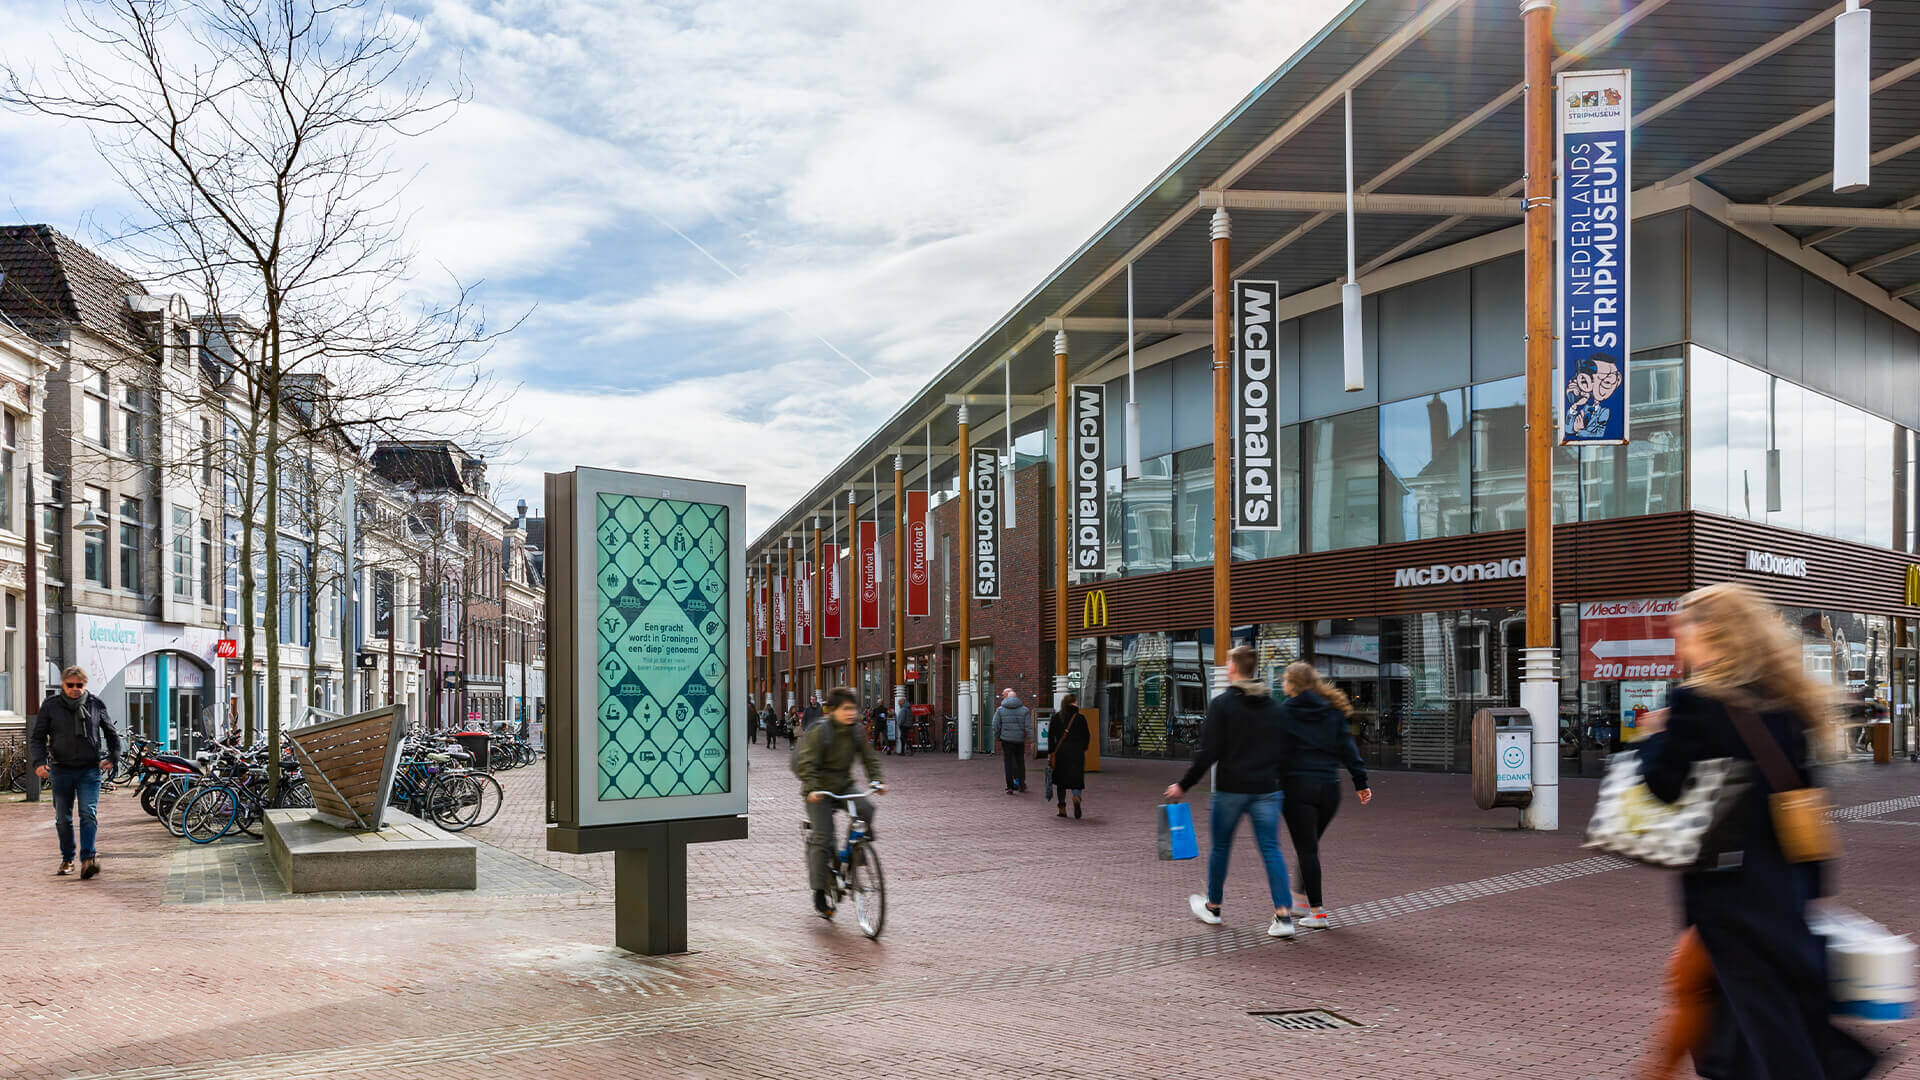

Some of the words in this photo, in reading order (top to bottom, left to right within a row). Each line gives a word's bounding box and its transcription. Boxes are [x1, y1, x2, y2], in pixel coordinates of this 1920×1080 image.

[1568, 111, 1621, 120] STRIPMUSEUM
[1571, 143, 1591, 296] NEDERLANDS
[1593, 141, 1618, 348] STRIPMUSEUM
[1571, 306, 1591, 348] HET
[1243, 287, 1273, 523] McDonald's
[1079, 390, 1101, 568] McDonald's
[978, 453, 996, 595] McDonald's
[913, 526, 924, 569] Kruidvat
[865, 551, 874, 589] Kruidvat
[1394, 556, 1527, 588] McDonald
[1746, 550, 1807, 577] McDonald's
[1584, 603, 1628, 617] Media
[1638, 600, 1680, 615] Markt
[90, 620, 137, 644] denderz
[629, 634, 651, 642] wordt
[661, 634, 698, 644] Groningen
[645, 623, 659, 631] Een
[660, 623, 684, 633] gracht
[219, 641, 236, 657] illy
[666, 646, 699, 655] genoemd
[1593, 663, 1622, 678] 200
[1624, 662, 1675, 677] meter
[1496, 773, 1530, 781] BEDANKT
